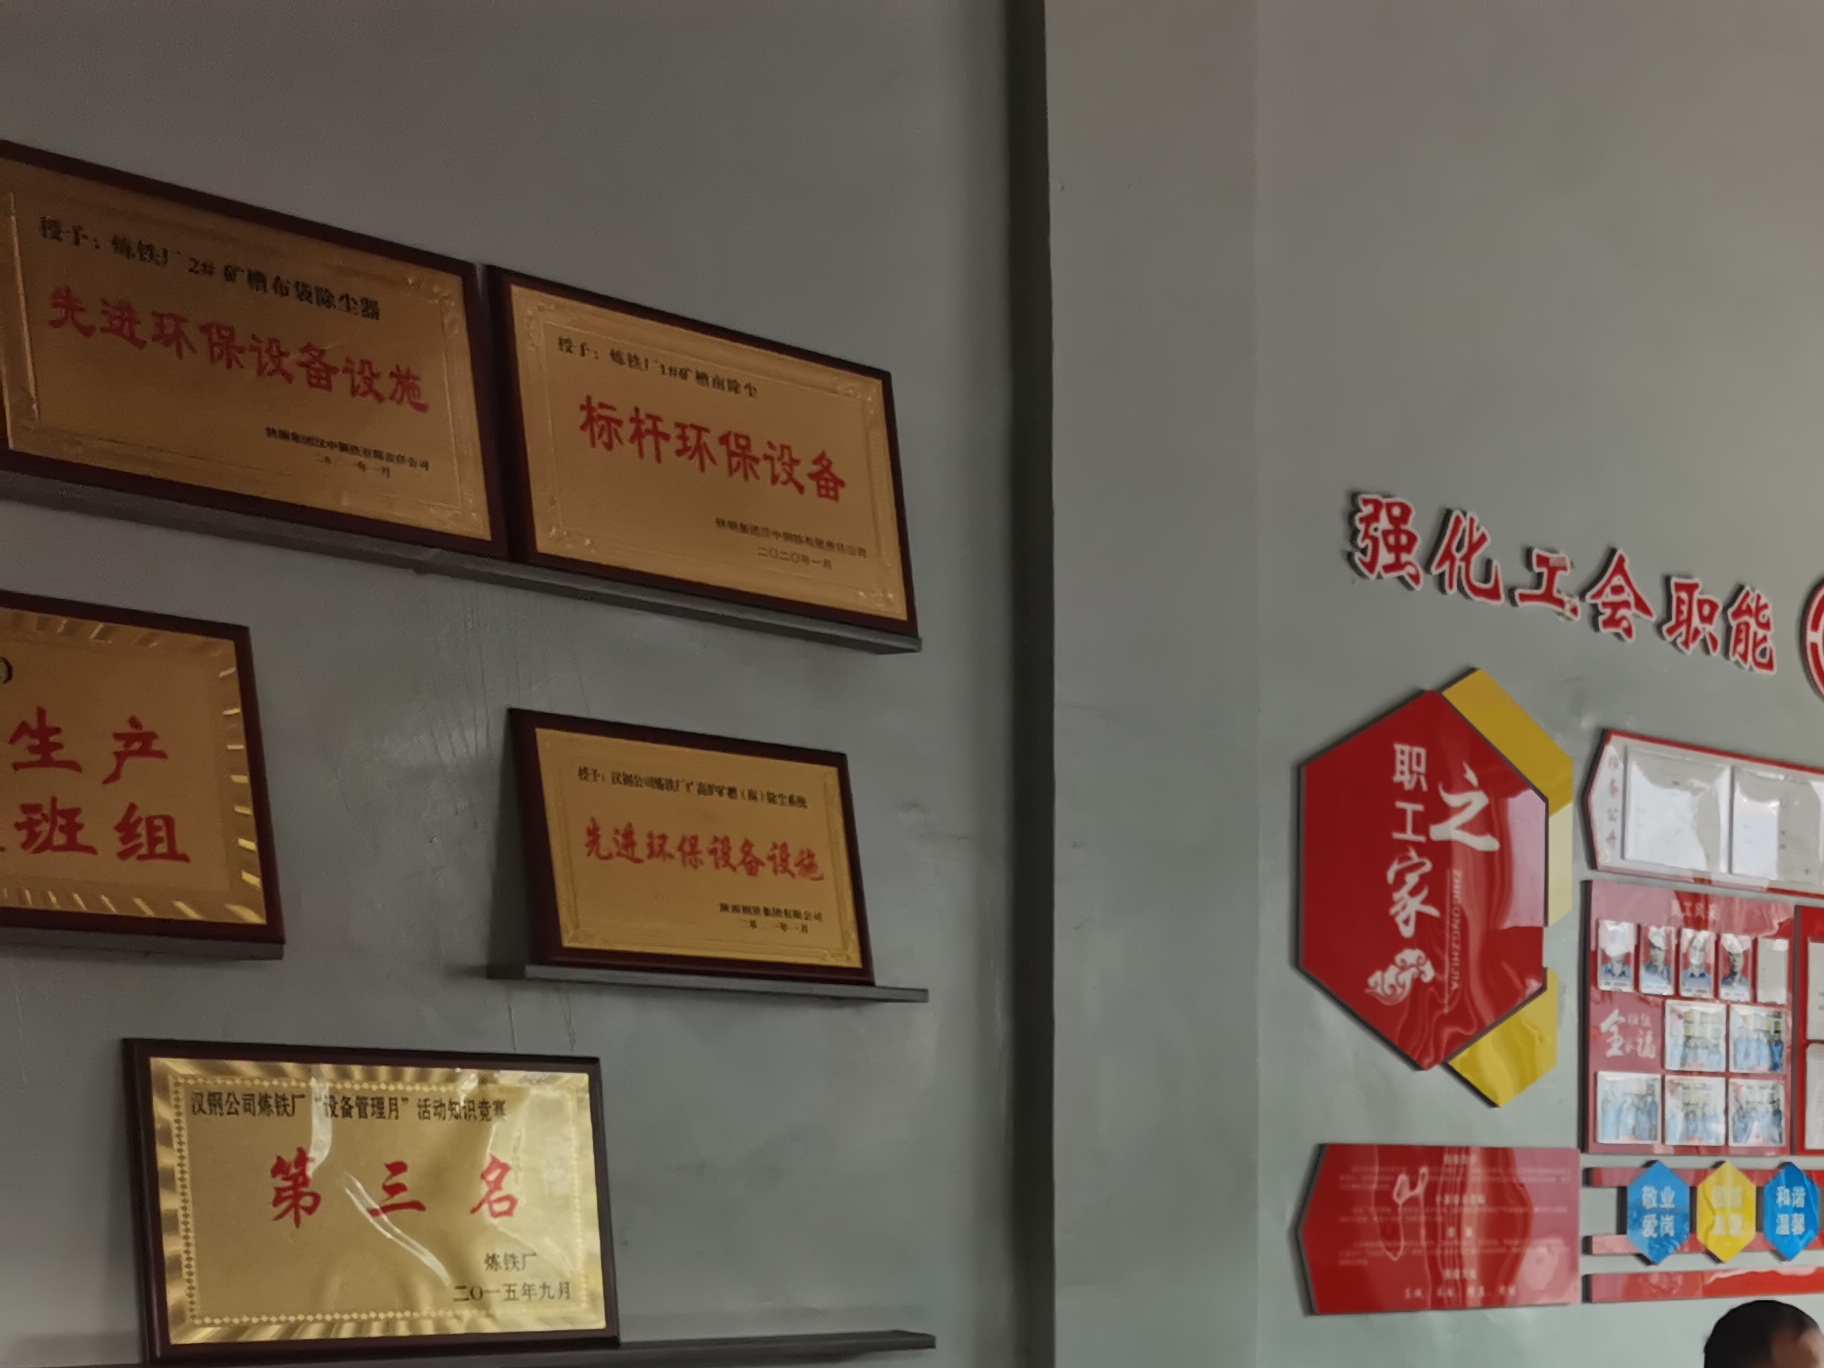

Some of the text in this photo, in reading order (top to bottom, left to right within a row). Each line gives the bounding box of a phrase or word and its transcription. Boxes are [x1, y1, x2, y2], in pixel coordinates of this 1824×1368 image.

[47, 284, 429, 412] 先进环保设备设施
[579, 395, 846, 502] 标杆环保设备
[1357, 494, 1777, 674] 强化工会职能
[8, 706, 168, 785] 生产
[0, 796, 190, 864] 班组
[584, 816, 824, 881] 先进环保设备设施
[270, 1147, 519, 1228] 第三名
[1641, 1214, 1676, 1239] 爱岗
[484, 1252, 537, 1271] 炼铁厂
